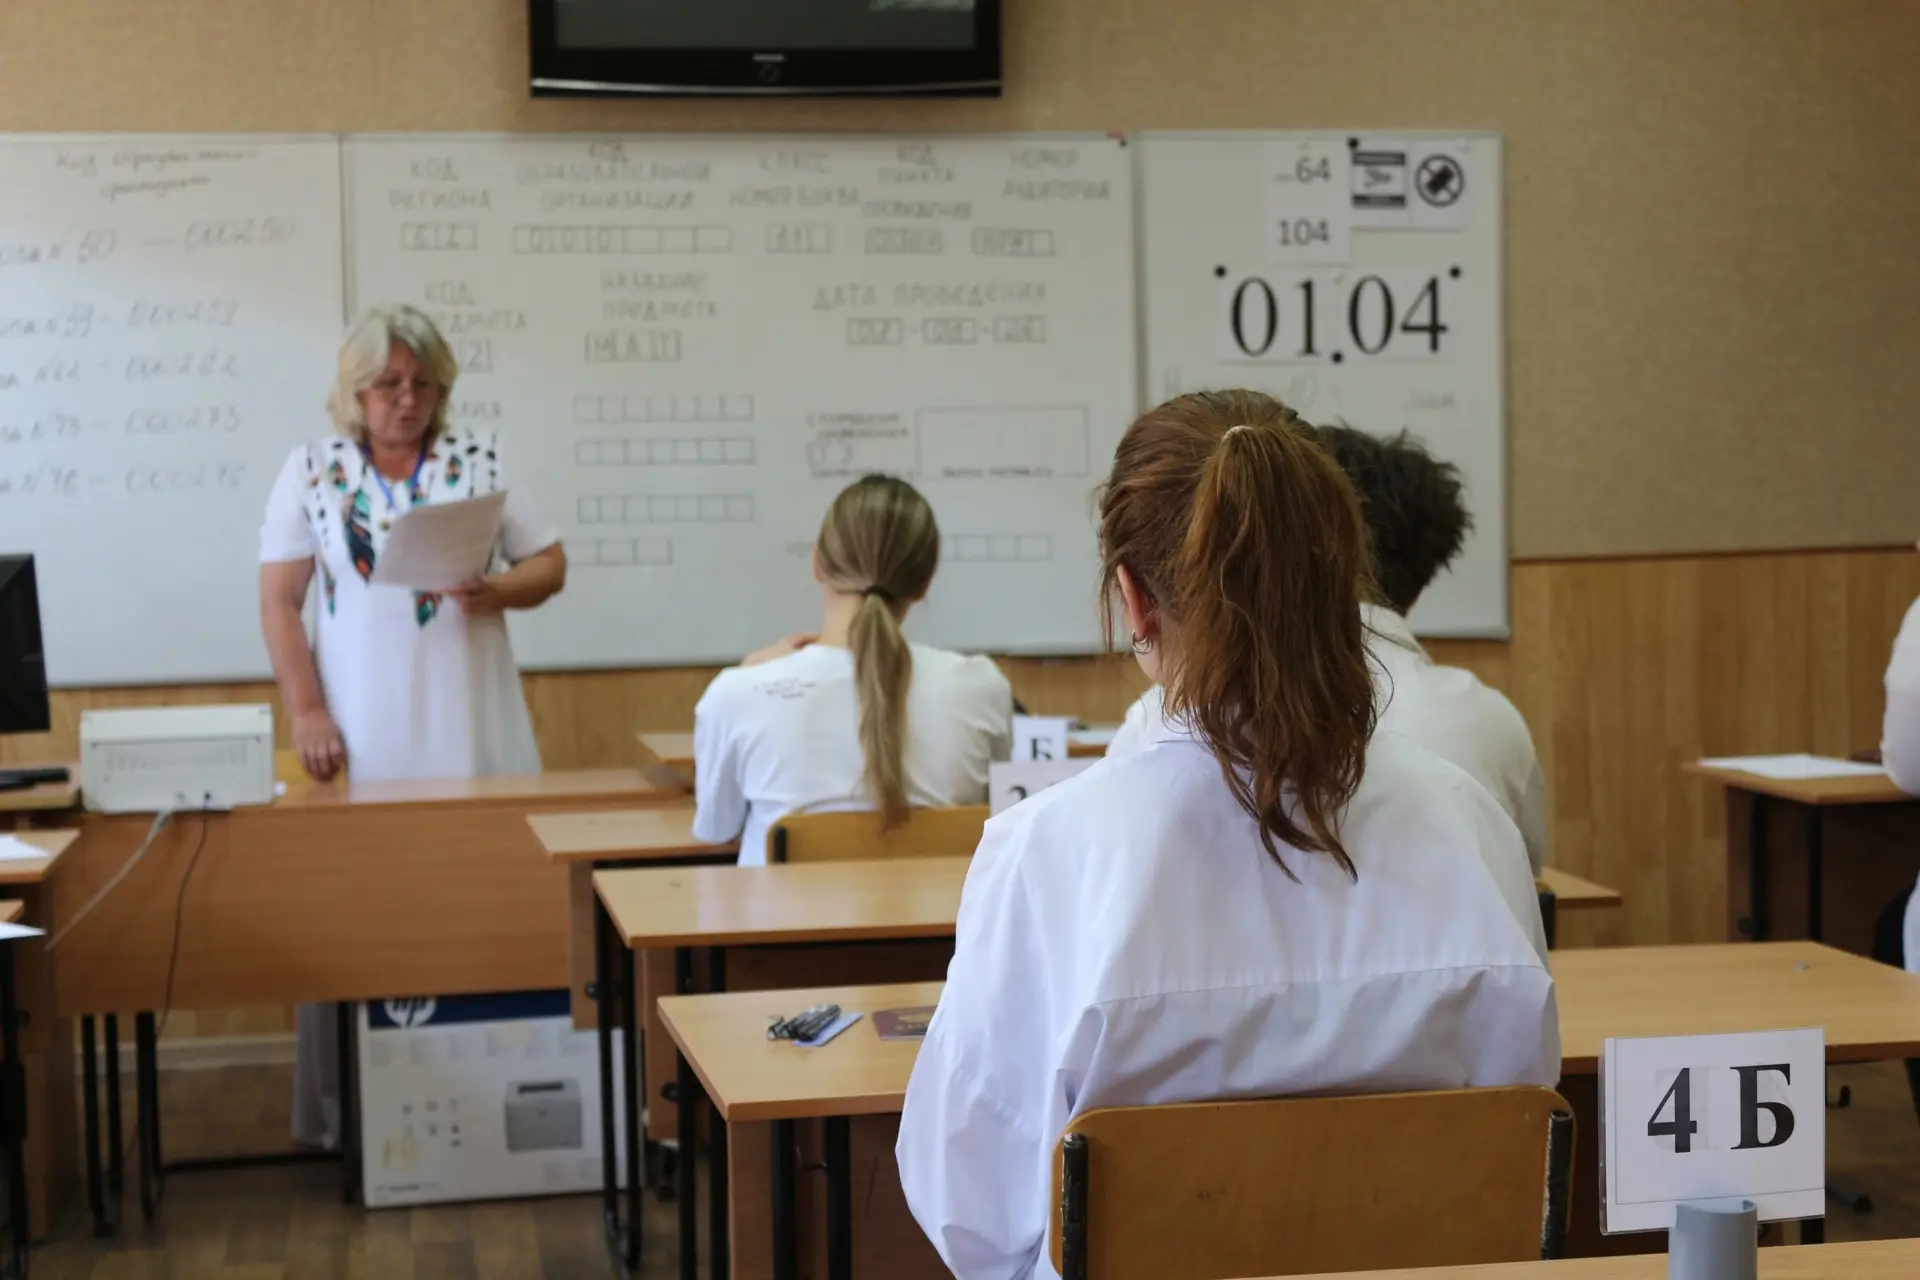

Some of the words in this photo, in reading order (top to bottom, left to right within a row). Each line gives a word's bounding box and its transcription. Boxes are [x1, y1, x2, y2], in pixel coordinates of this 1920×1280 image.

[1278, 218, 1330, 246] 104
[1231, 274, 1448, 364] 01.04
[1647, 1067, 1697, 1153] 4
[1729, 1063, 1795, 1150] Б
